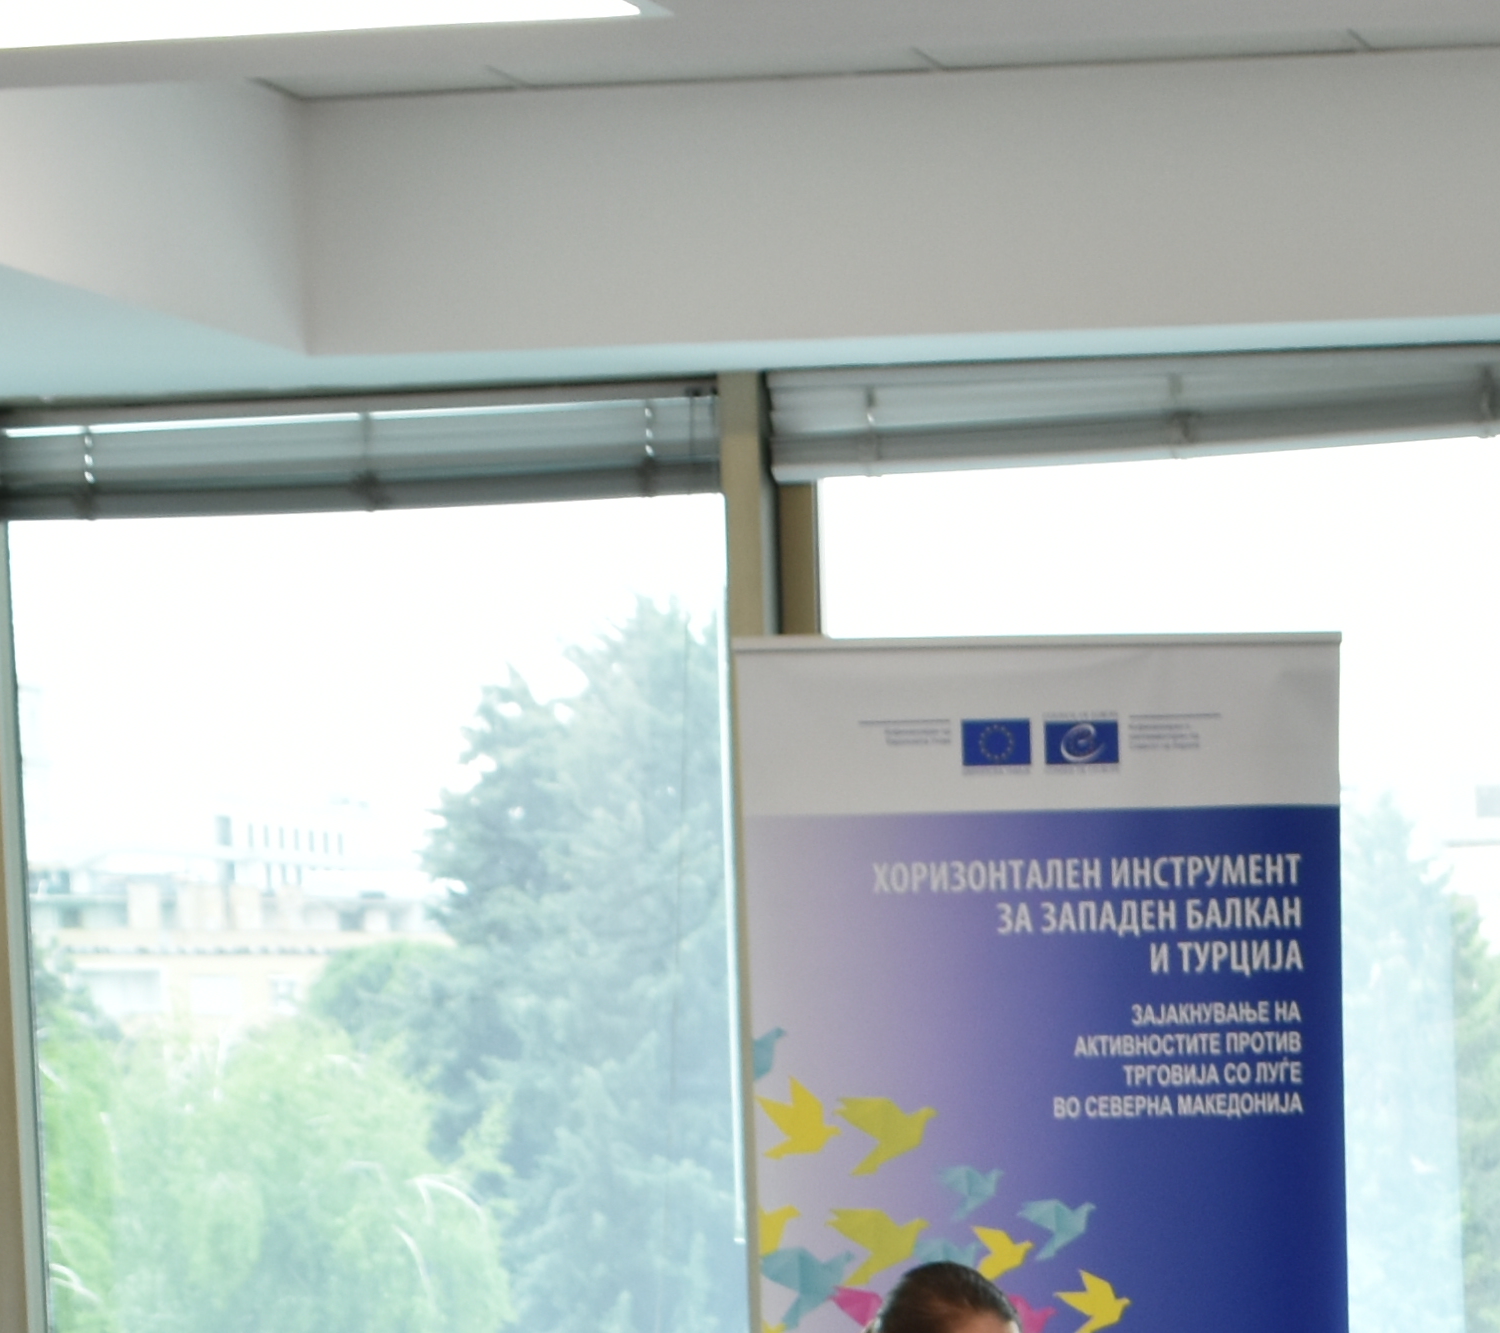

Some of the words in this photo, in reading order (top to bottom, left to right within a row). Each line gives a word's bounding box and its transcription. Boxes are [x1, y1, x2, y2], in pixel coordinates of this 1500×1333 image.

[873, 858, 1101, 894] ХОРИЗОНТАЛЕН
[1111, 853, 1301, 888] ИНСТРУМЕНТ
[997, 902, 1033, 935] ЗА
[1041, 899, 1176, 937] ЗАПАДЕН
[1186, 897, 1302, 930] БАЛКАН
[1150, 942, 1169, 974] И
[1177, 938, 1303, 977] ТУРЦИЈА
[1131, 1001, 1270, 1026] ЗАЈАКНУВАЊЕ
[1274, 1000, 1302, 1023] НА
[1073, 1032, 1221, 1057] АКТИВНОСТИТЕ
[1225, 1031, 1302, 1054] ПРОТИВ
[1122, 1063, 1219, 1087] ТРГОВИЈА
[1223, 1061, 1251, 1085] СО
[1053, 1096, 1080, 1119] ВО
[1084, 1094, 1173, 1119] СЕВЕРНА
[1177, 1092, 1304, 1119] МАКЕДОНИЈА
